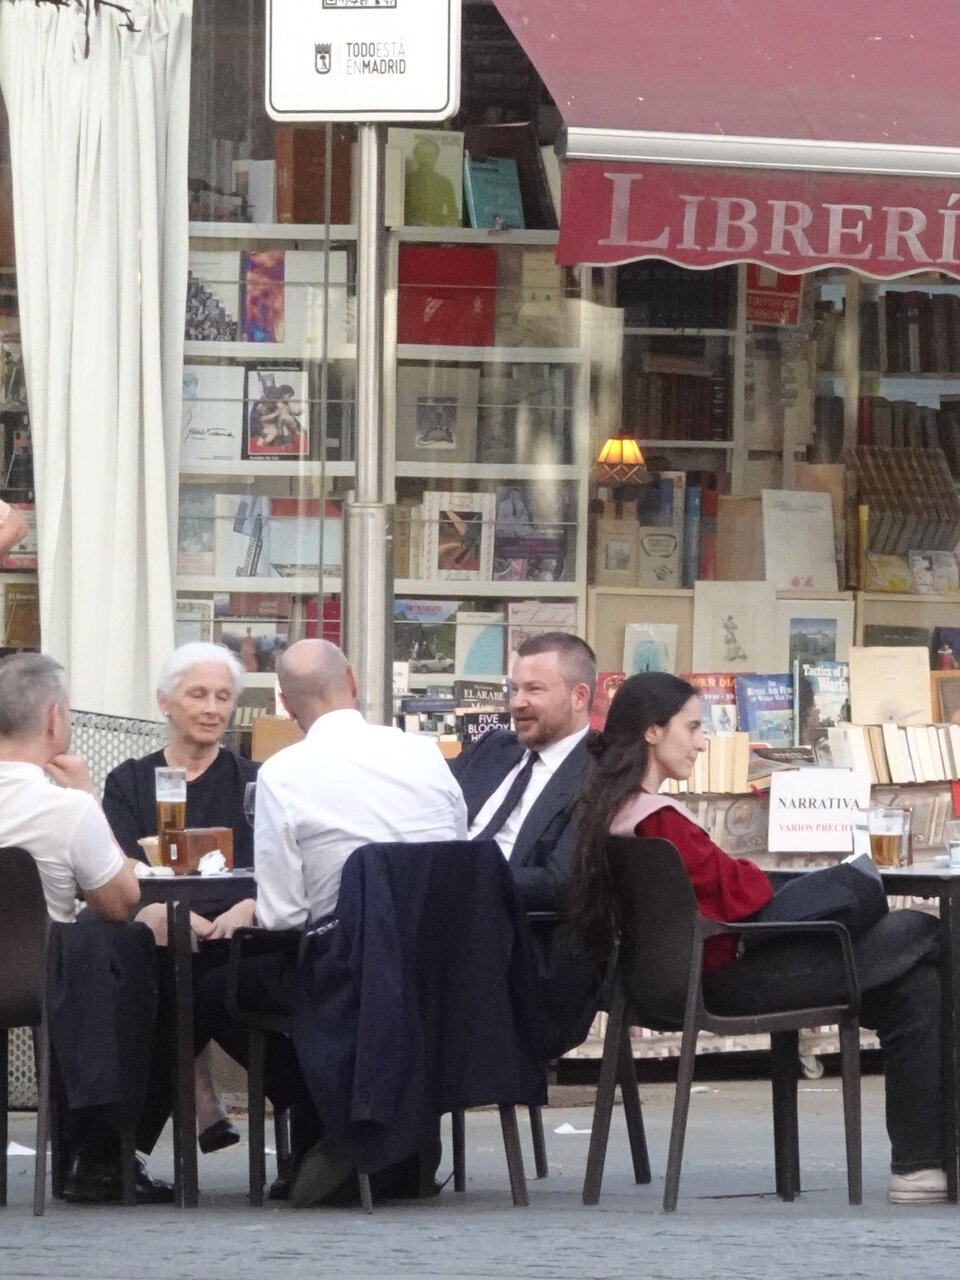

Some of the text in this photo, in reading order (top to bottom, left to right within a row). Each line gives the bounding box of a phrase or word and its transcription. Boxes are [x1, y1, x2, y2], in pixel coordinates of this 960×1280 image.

[464, 689, 477, 699] EL
[479, 713, 499, 724] FIVE
[468, 723, 509, 734] BLOODY
[778, 797, 860, 810] NARRATIVA
[778, 823, 853, 832] VARIOS PRECIO
